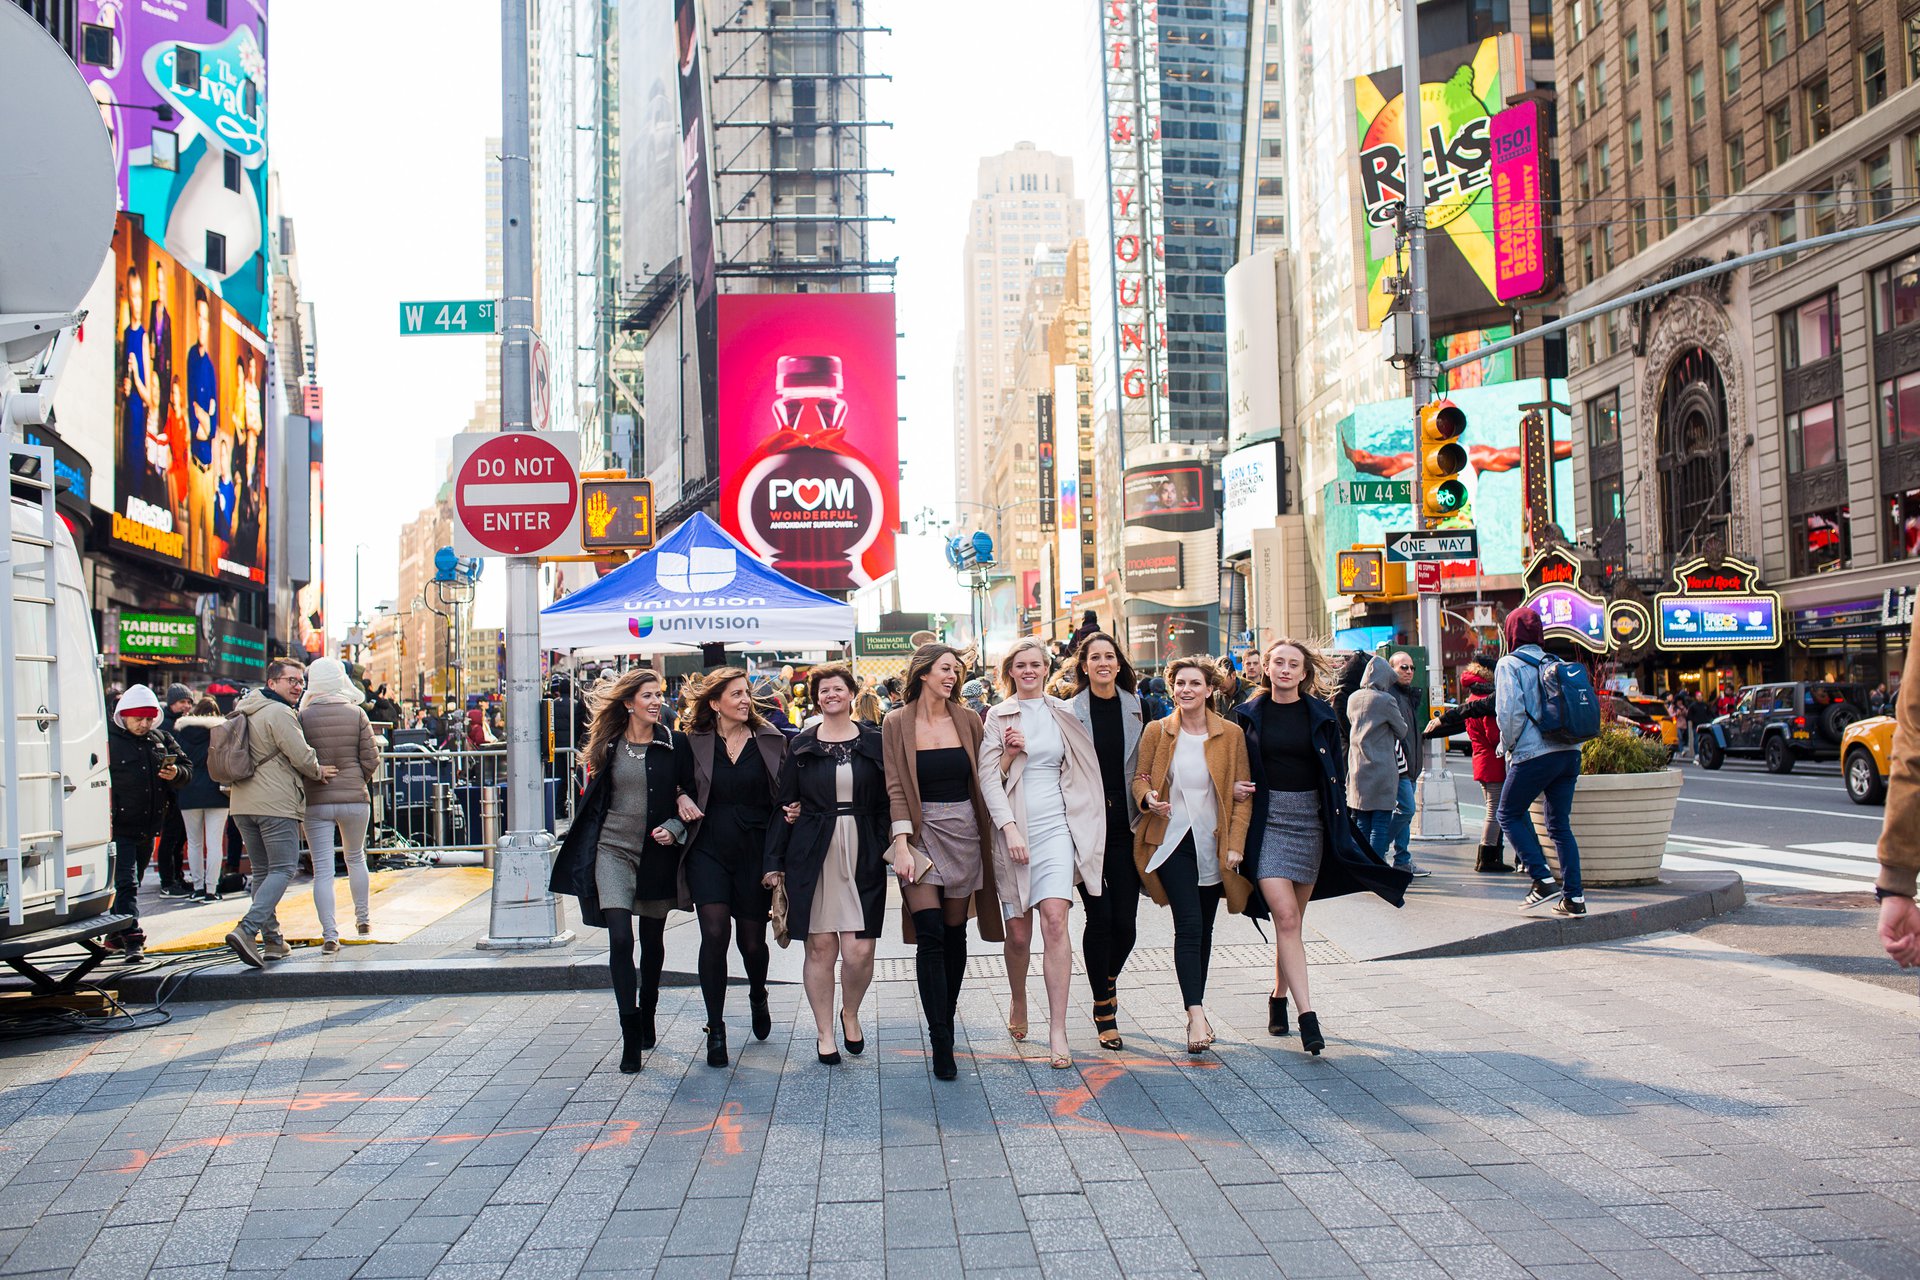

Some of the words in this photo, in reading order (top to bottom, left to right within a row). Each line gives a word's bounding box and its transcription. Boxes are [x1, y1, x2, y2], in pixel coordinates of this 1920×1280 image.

[1494, 124, 1532, 155] 1501
[1497, 172, 1514, 280] FLAGSHIP
[1523, 164, 1537, 273] OPPORTUNITY
[1511, 199, 1528, 277] RETAIL
[1116, 188, 1145, 399] YOUNG
[405, 305, 425, 331] W
[434, 304, 467, 331] 44
[478, 304, 493, 318] ST
[477, 458, 506, 477] DO
[515, 457, 555, 477] NOT
[768, 478, 855, 511] POM
[1353, 484, 1367, 501] W
[1374, 484, 1394, 501] 44
[1400, 483, 1411, 495] St
[483, 511, 551, 532] ENTER
[632, 495, 648, 536] 3
[1400, 540, 1426, 552] ONE
[1438, 538, 1466, 551] WAY
[1127, 555, 1177, 569] moviepass
[1369, 560, 1380, 586] 3
[1541, 564, 1557, 584] Hard
[1557, 562, 1573, 582] Rock
[1687, 576, 1714, 589] Hard
[1714, 575, 1741, 591] Rock
[126, 635, 179, 648] COFFEE
